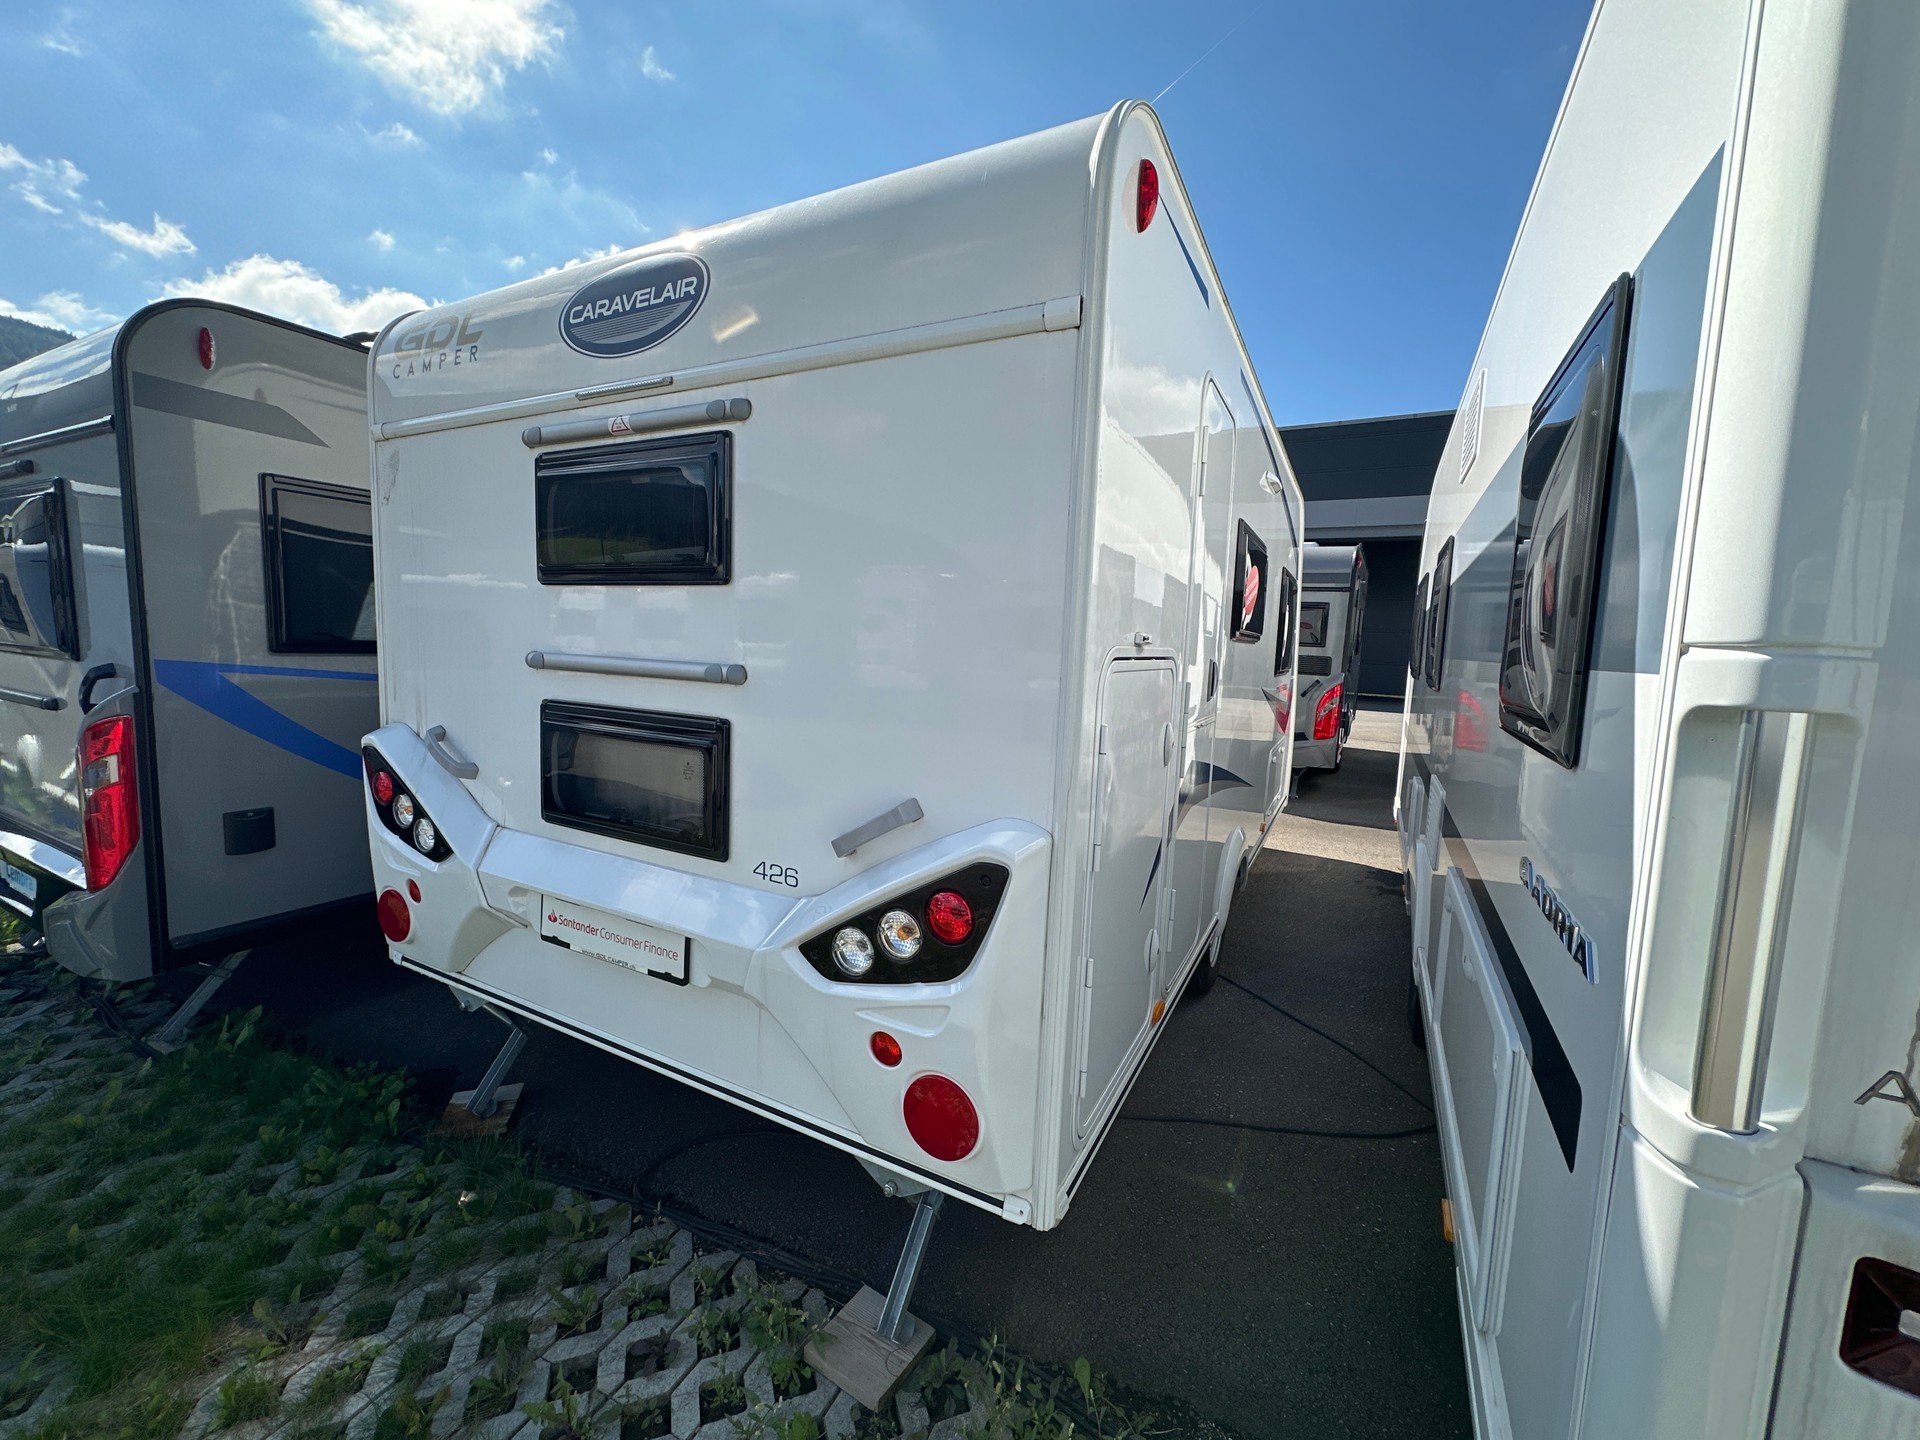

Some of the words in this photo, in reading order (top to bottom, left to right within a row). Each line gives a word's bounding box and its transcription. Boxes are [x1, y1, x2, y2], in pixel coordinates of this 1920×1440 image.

[569, 276, 698, 324] CARAVELAIR
[394, 313, 483, 359] GDL
[393, 345, 478, 379] CAMPER
[753, 861, 799, 888] 426
[558, 914, 599, 936] Santander
[600, 927, 643, 949] Consumer
[643, 940, 679, 961] Finance
